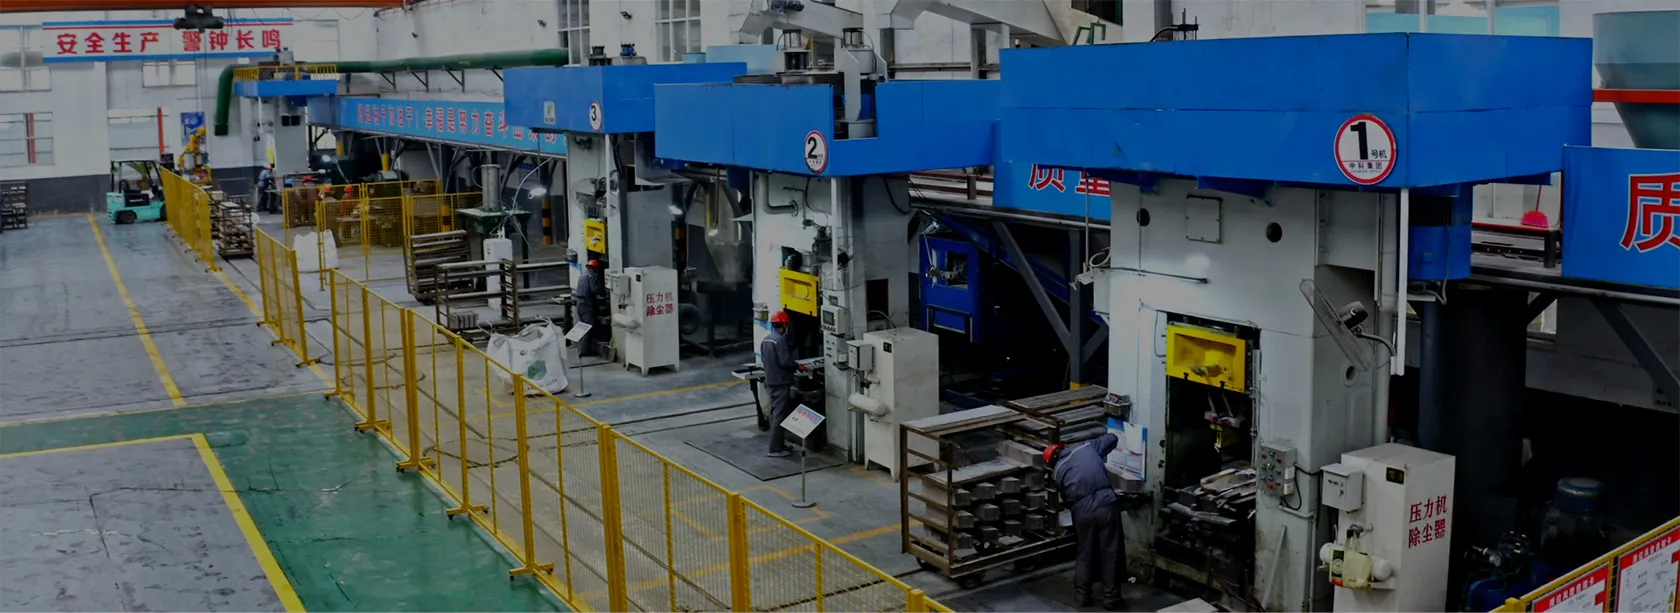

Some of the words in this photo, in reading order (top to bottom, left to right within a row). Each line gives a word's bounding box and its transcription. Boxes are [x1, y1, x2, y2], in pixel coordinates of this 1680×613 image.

[56, 32, 160, 55] 安全生产
[182, 29, 281, 52] 警钟长鸣
[590, 105, 597, 121] 3
[807, 136, 818, 159] 2
[1348, 162, 1383, 170] 中科集团
[1619, 172, 1680, 253] 质
[646, 292, 674, 303] 压力机
[646, 303, 674, 316] 除尘器
[1408, 494, 1448, 524] 压力机
[1407, 518, 1447, 549] 除尘器
